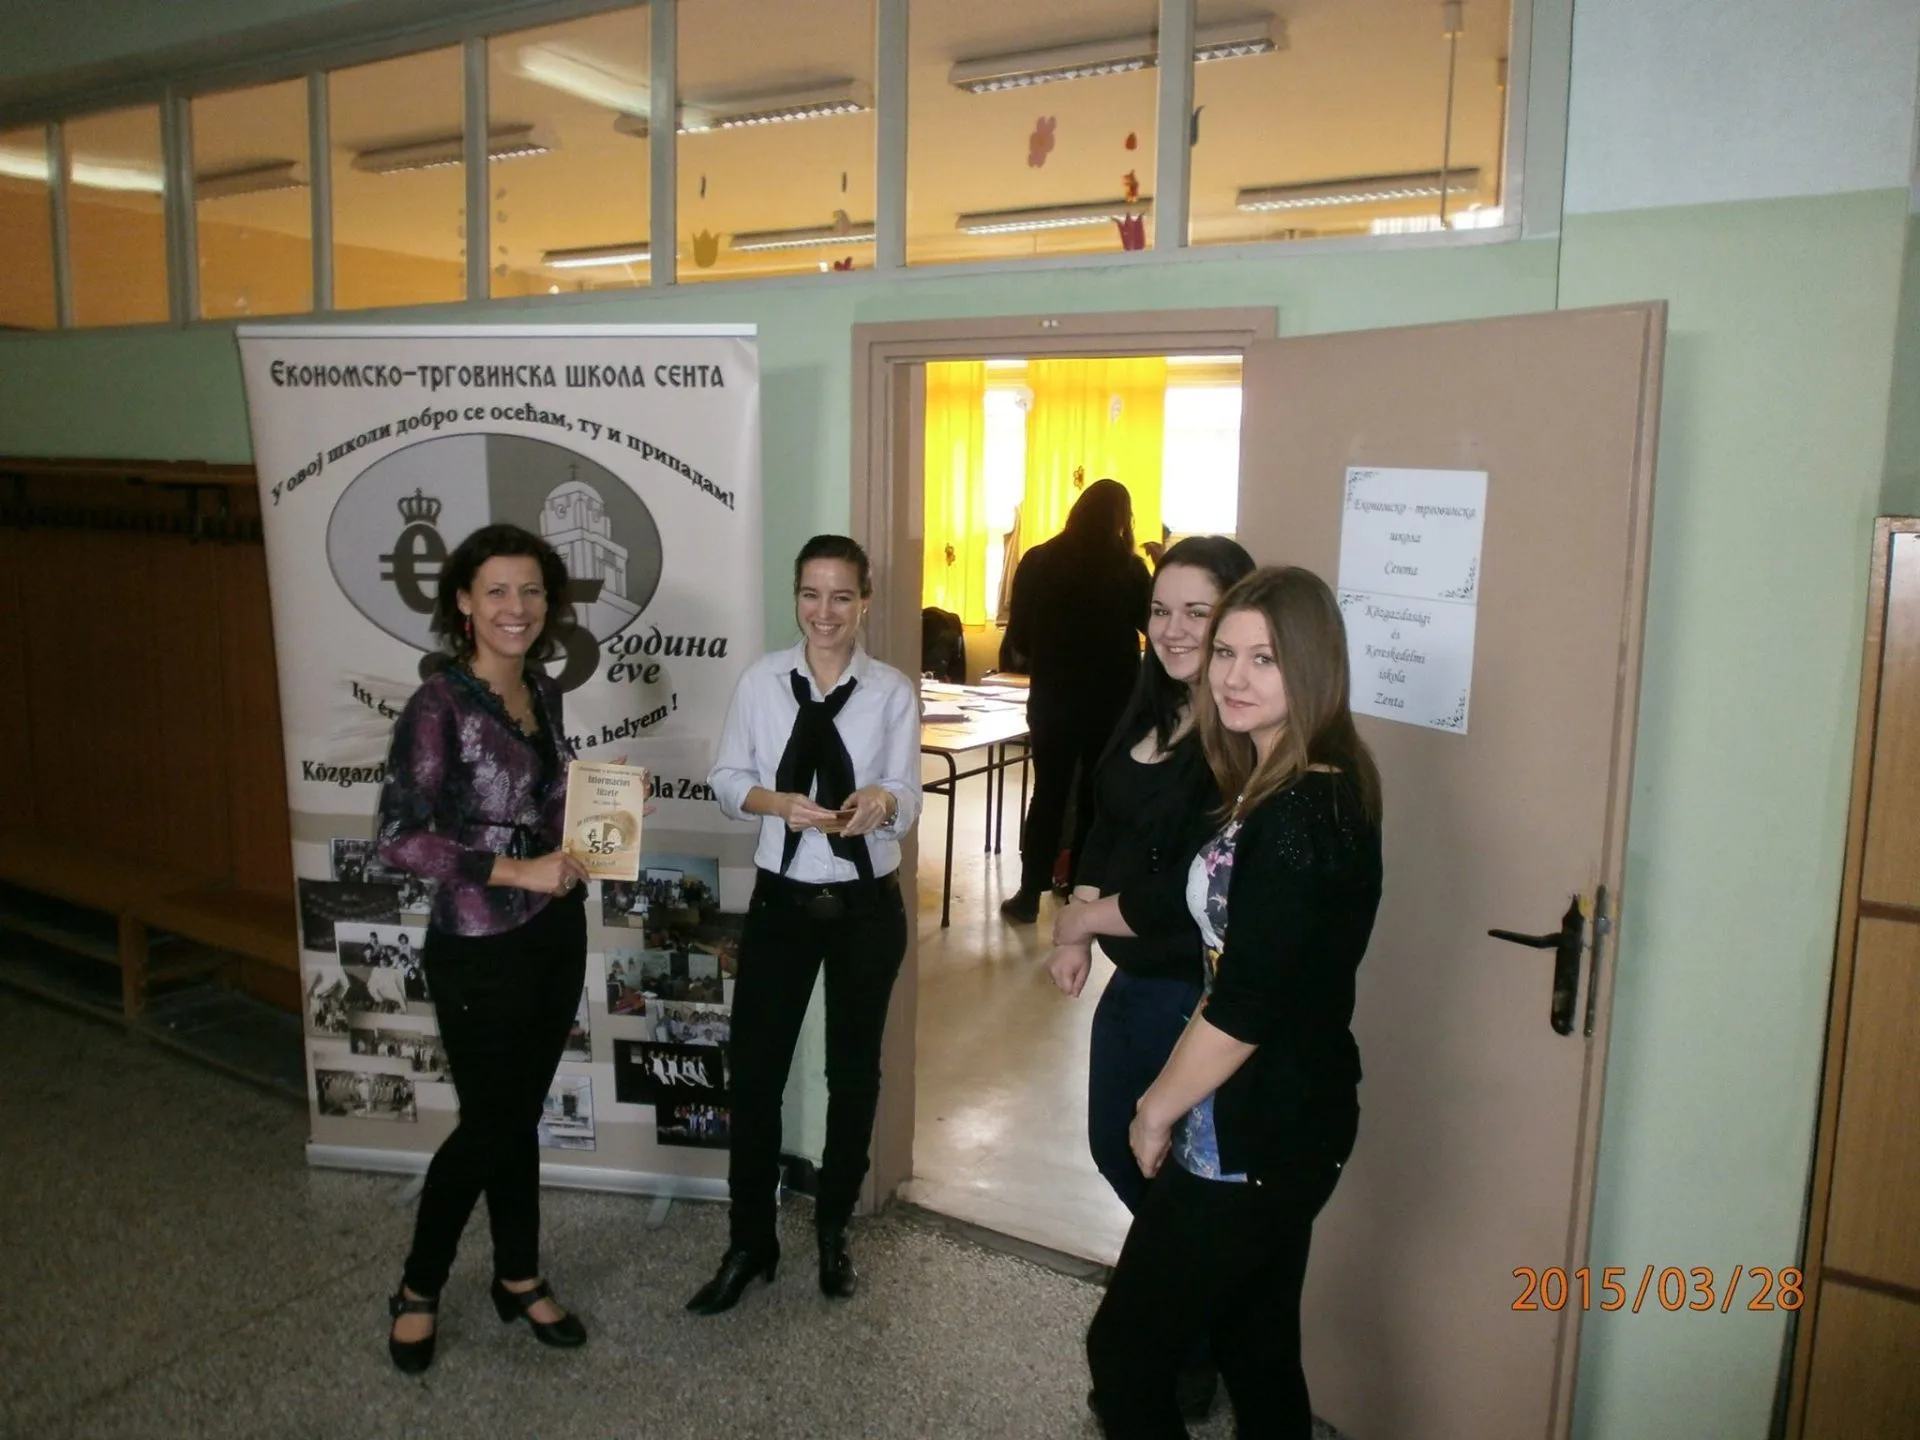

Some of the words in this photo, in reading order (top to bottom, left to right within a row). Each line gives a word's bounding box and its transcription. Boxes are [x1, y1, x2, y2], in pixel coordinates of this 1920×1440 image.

[286, 451, 324, 492] овој
[327, 423, 392, 465] школи
[396, 407, 458, 437] добро
[464, 406, 485, 421] се
[490, 402, 574, 431] осећам,
[577, 417, 603, 441] ту
[606, 425, 622, 444] и
[626, 433, 736, 512] припадам!
[1384, 561, 1419, 576] Сента
[1365, 604, 1432, 628] Közgazdasági
[607, 625, 729, 659] година
[1365, 644, 1426, 665] Kereskedelmi
[606, 653, 661, 685] éve
[1379, 667, 1407, 684] iskola
[352, 680, 374, 709] Itt
[377, 698, 402, 720] ér
[586, 735, 599, 748] a
[601, 703, 668, 745] helyem
[1374, 691, 1405, 709] Zenta
[301, 760, 387, 788] Közgazd
[677, 777, 718, 802] Zen
